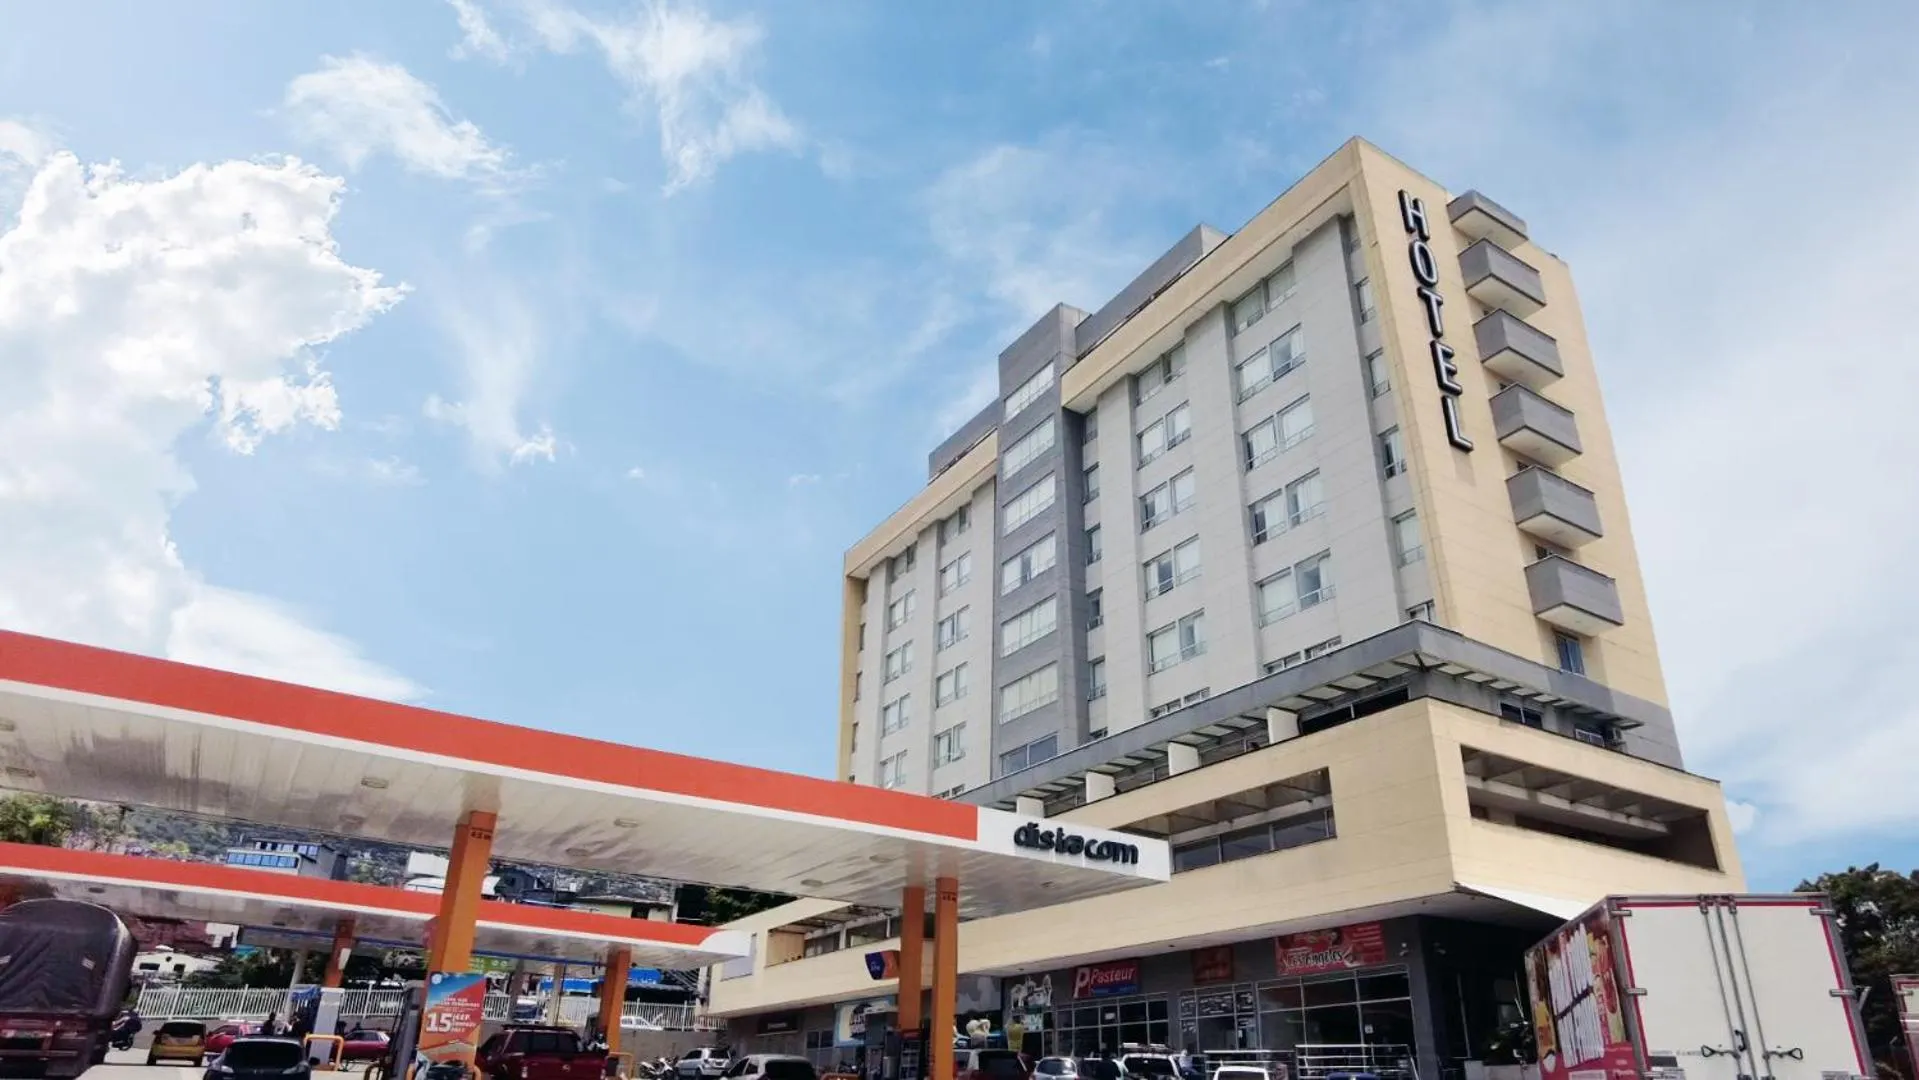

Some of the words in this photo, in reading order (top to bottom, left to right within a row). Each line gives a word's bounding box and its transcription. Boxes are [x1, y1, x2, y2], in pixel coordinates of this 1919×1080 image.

[1398, 189, 1474, 452] HOTEL
[1090, 967, 1136, 985] Pasteur
[425, 1012, 453, 1032] 15
